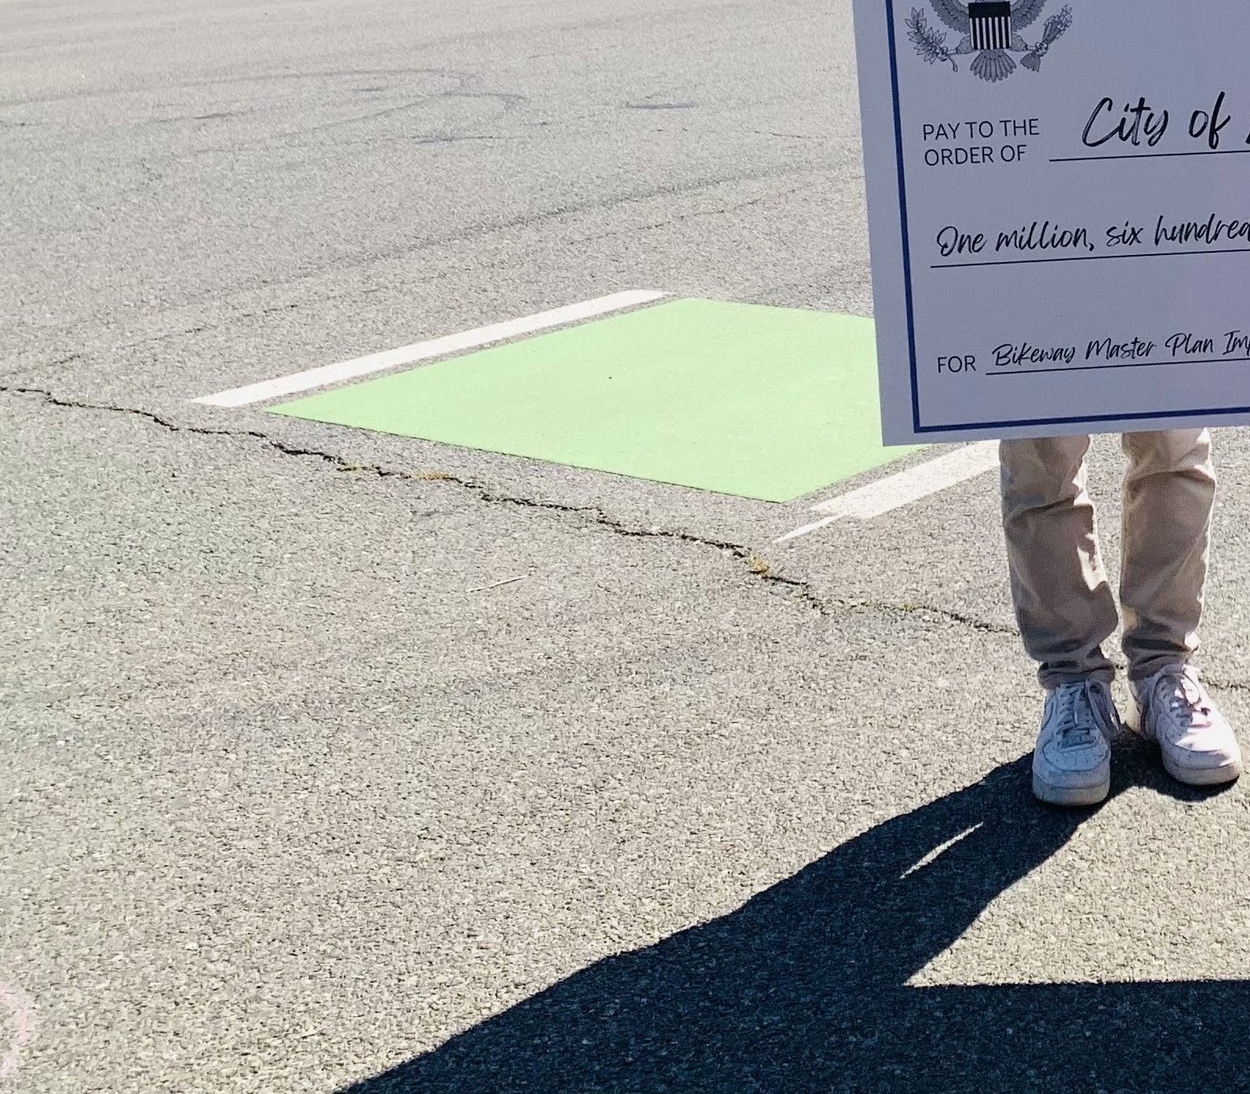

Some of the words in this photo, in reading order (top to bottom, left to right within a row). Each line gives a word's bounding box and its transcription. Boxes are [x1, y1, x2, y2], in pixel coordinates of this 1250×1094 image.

[922, 122, 961, 142] PAY
[964, 120, 994, 139] TO
[998, 117, 1041, 138] THE
[1081, 96, 1169, 148] City
[1187, 90, 1232, 150] of
[924, 145, 995, 167] ORDER
[1000, 143, 1028, 163] OF
[936, 225, 988, 258] One
[994, 220, 1095, 253] million,
[1105, 220, 1144, 248] six
[937, 354, 977, 374] FOR
[991, 341, 1076, 367] Bikeway
[1084, 336, 1158, 361] Master
[1164, 332, 1214, 357] Plan
